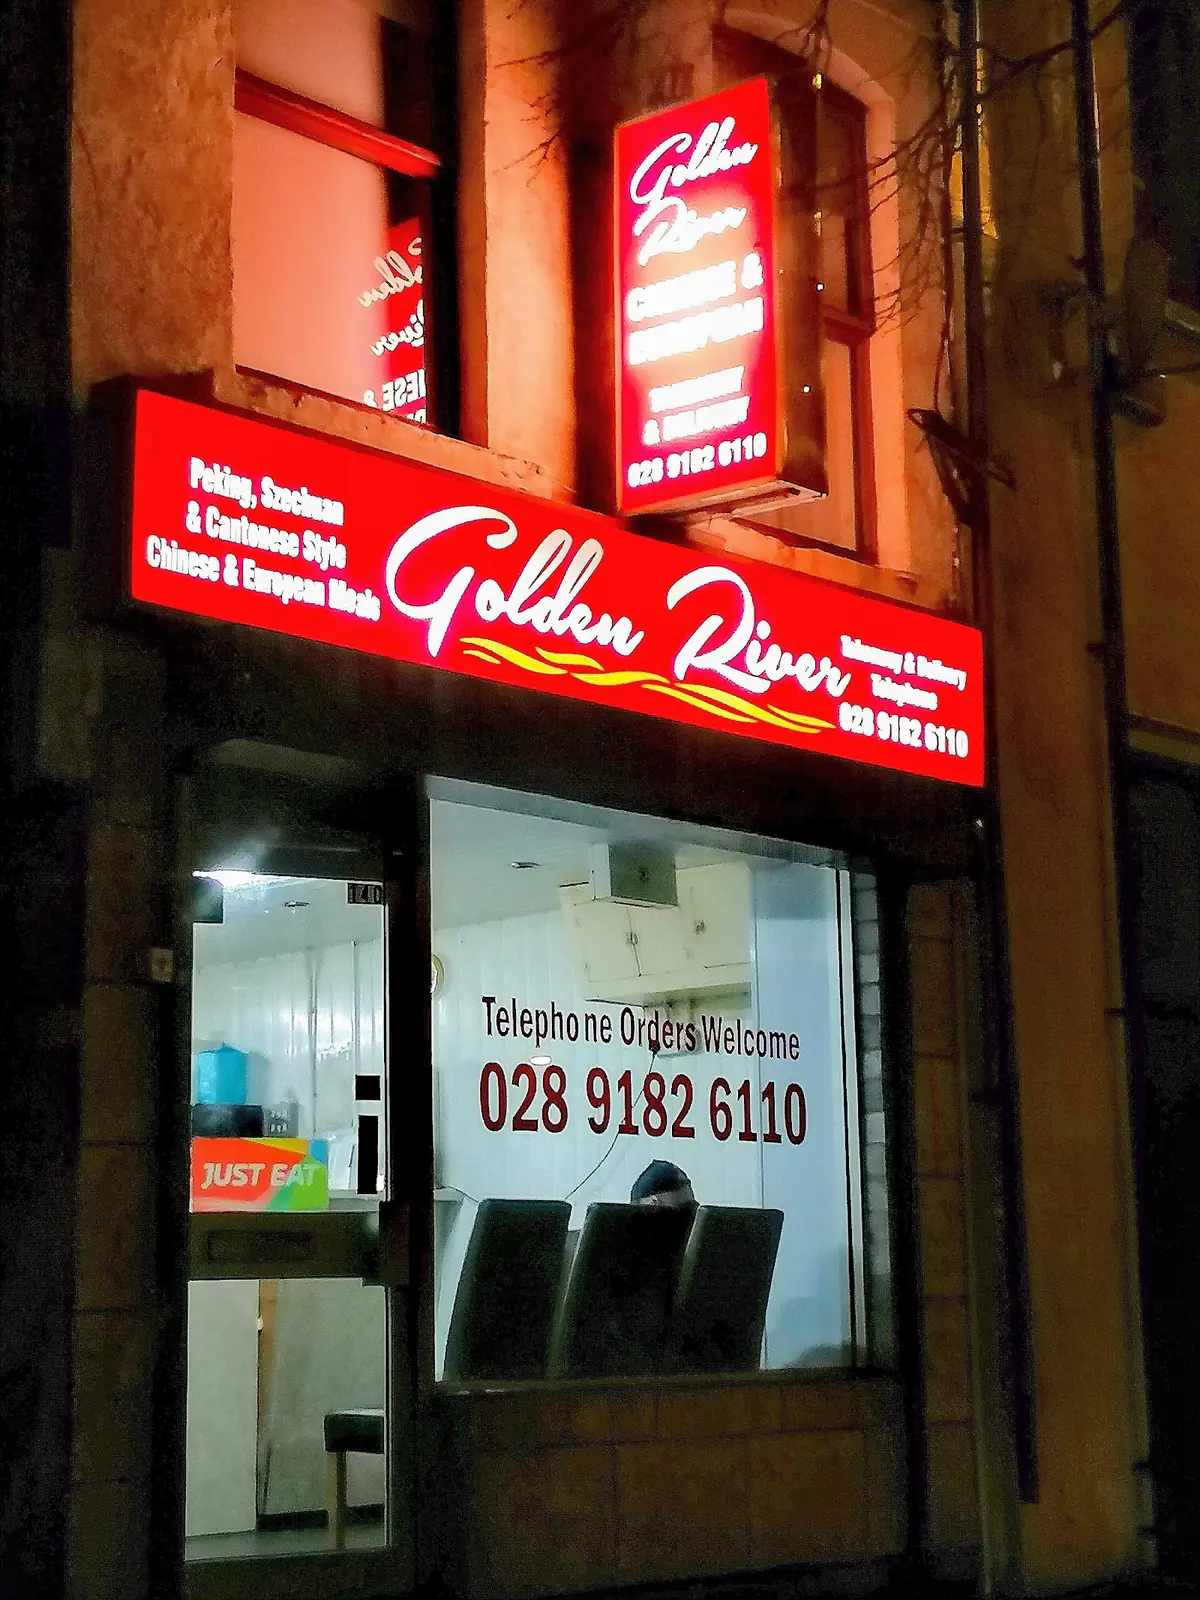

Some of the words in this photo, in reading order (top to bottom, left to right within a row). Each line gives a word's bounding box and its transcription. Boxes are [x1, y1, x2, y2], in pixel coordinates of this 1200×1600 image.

[190, 456, 257, 509] Peking,
[147, 534, 220, 583] Chinese
[223, 553, 240, 587] &
[243, 557, 326, 605] European
[185, 500, 202, 534] &
[205, 505, 300, 558] Cantonese
[302, 529, 347, 571] Style
[385, 505, 645, 657] Golden
[666, 565, 852, 698] River
[838, 701, 875, 737] 028
[876, 711, 923, 748] 9182
[924, 722, 969, 758] 6110
[481, 996, 612, 1048] Telephone
[620, 1006, 697, 1052] Orders
[701, 1014, 800, 1061] Welcome
[479, 1061, 569, 1134] 028
[585, 1066, 696, 1139] 9182
[709, 1077, 807, 1146] 6110
[200, 1162, 266, 1190] JUST
[270, 1162, 318, 1187] EAT
